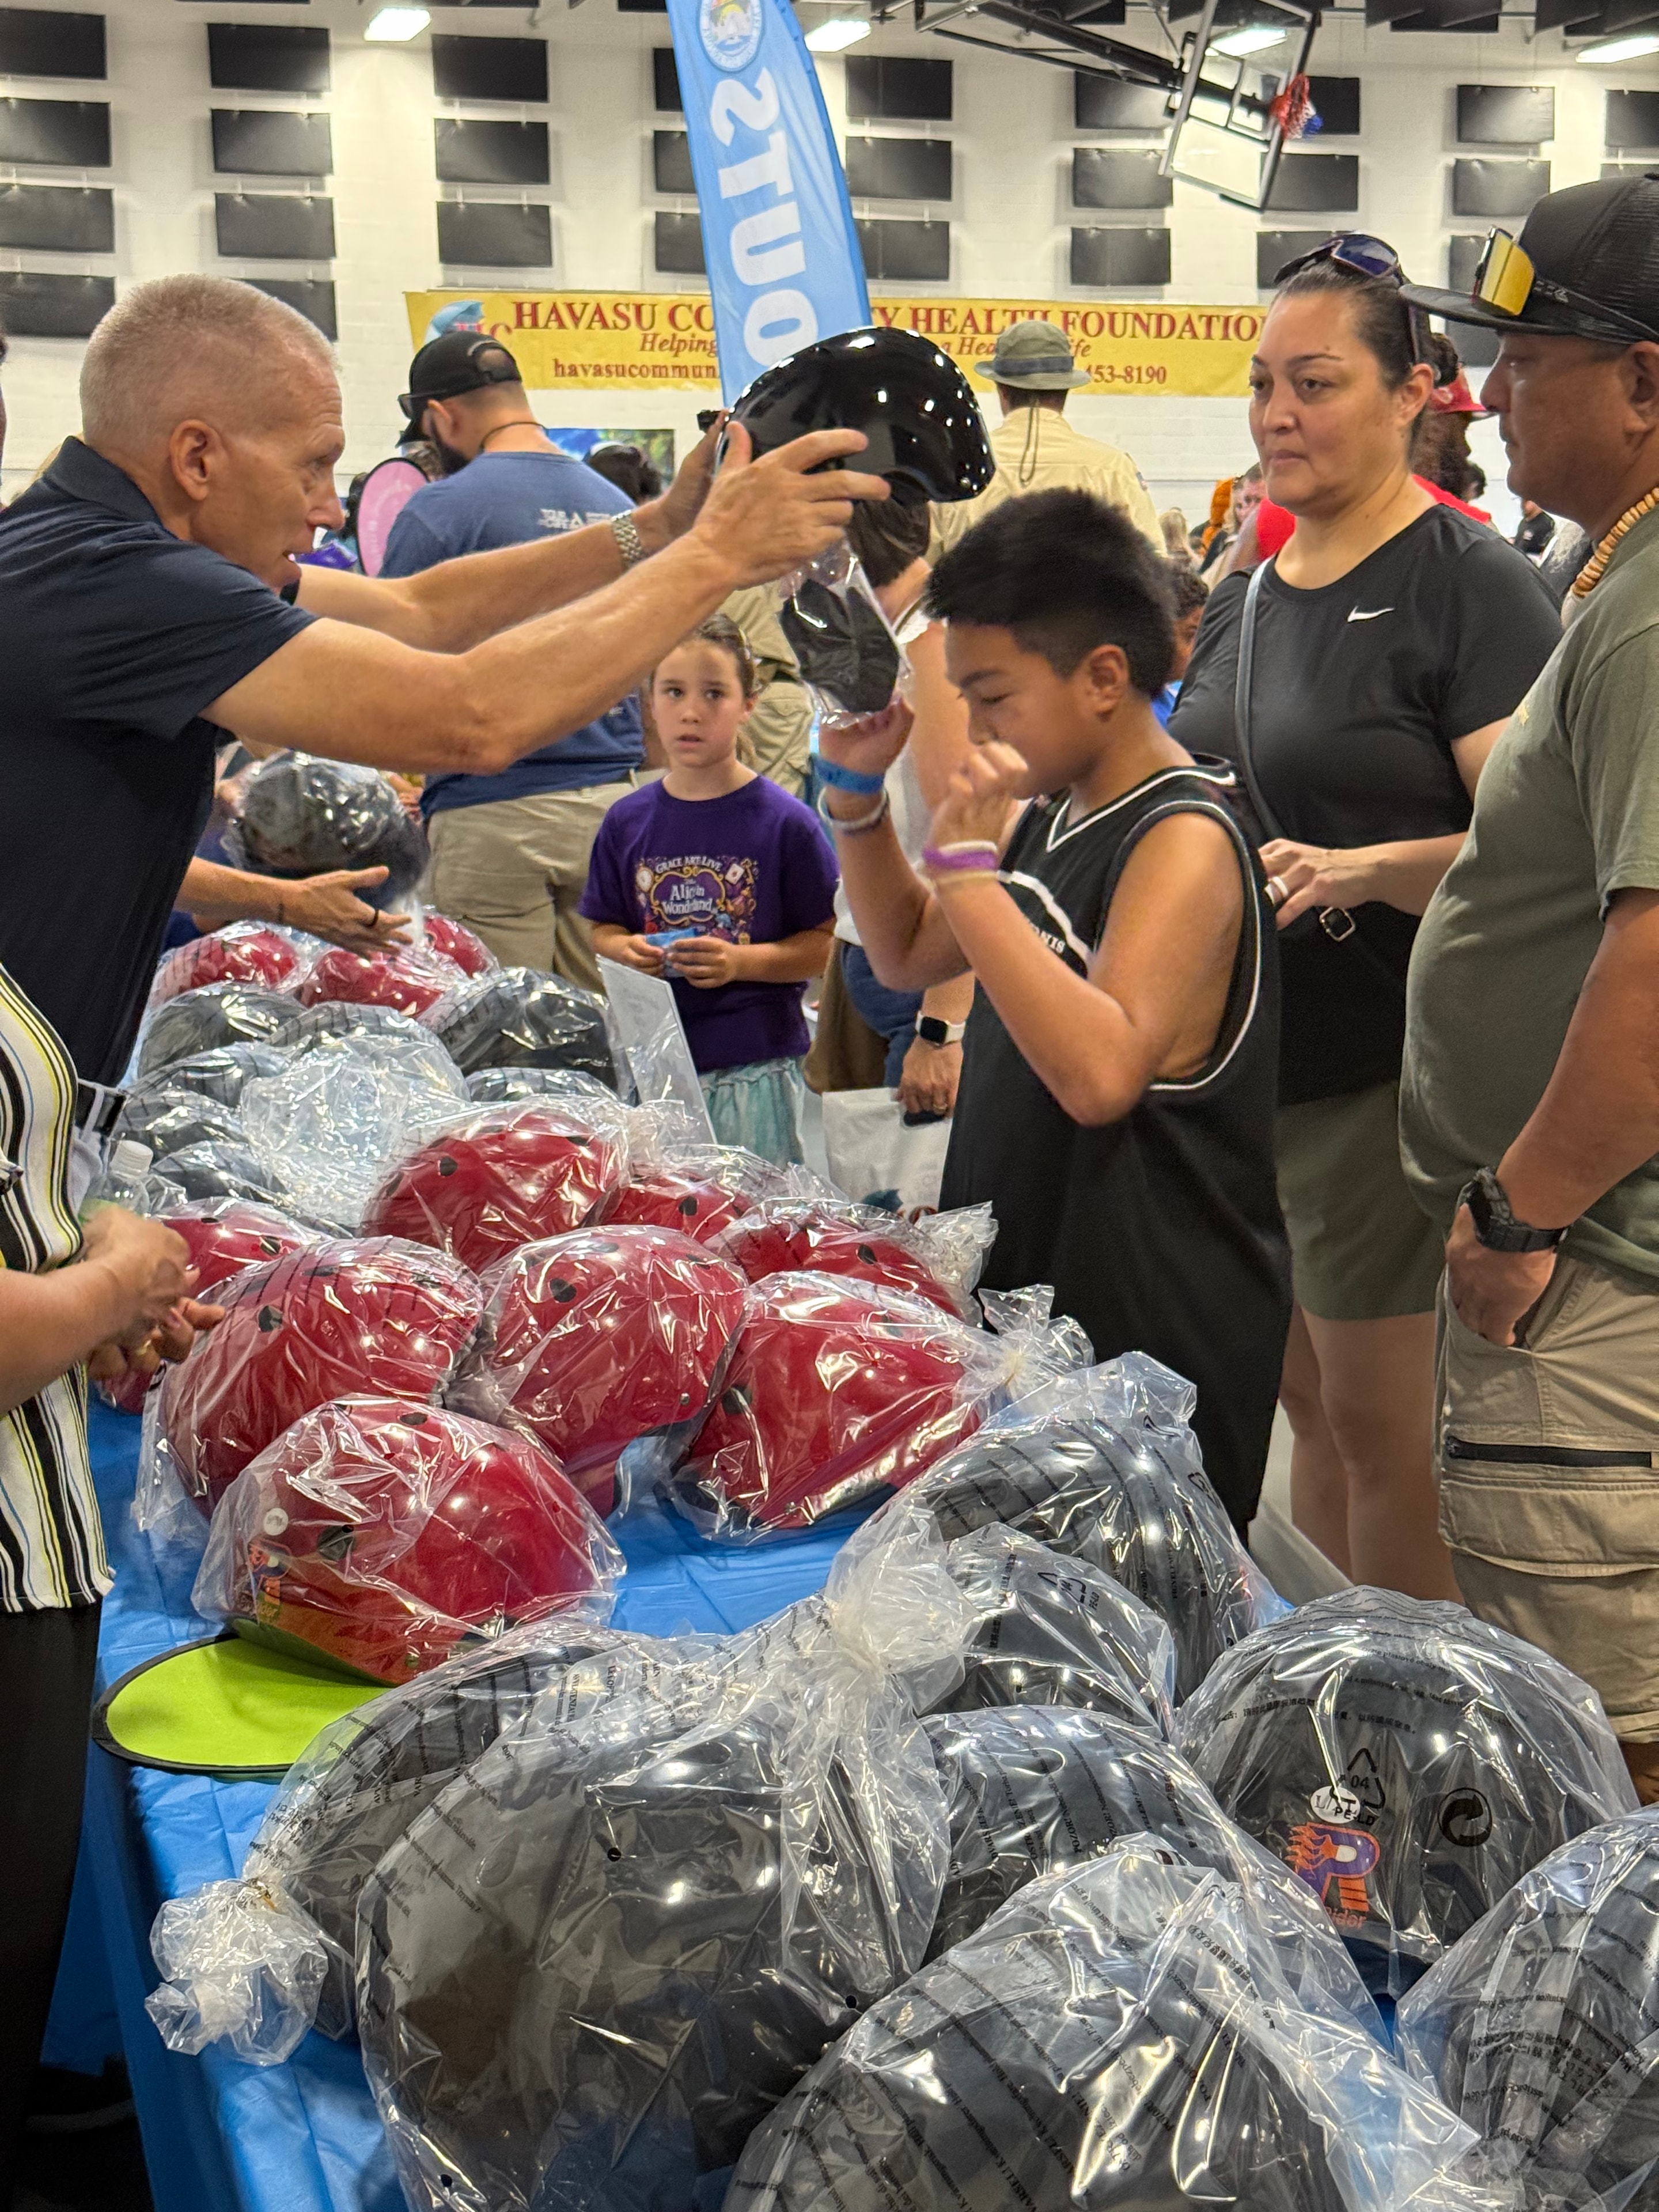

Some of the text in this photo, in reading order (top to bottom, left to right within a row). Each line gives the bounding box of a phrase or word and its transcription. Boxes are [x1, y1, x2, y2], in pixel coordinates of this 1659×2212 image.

[512, 301, 658, 331] HAVASU
[1062, 309, 1269, 341] FOUNDATIO
[954, 338, 995, 356] Hea
[1067, 339, 1091, 357] ife
[553, 358, 719, 378] havasucommun
[655, 855, 723, 874] GRACE ART LIVE
[1351, 1775, 1369, 1789] 04
[1334, 1806, 1376, 1826] PE-LD
[1060, 1816, 1087, 1855] POZOR!
[1083, 1899, 1101, 1918] távol
[827, 2187, 847, 2212] Houd
